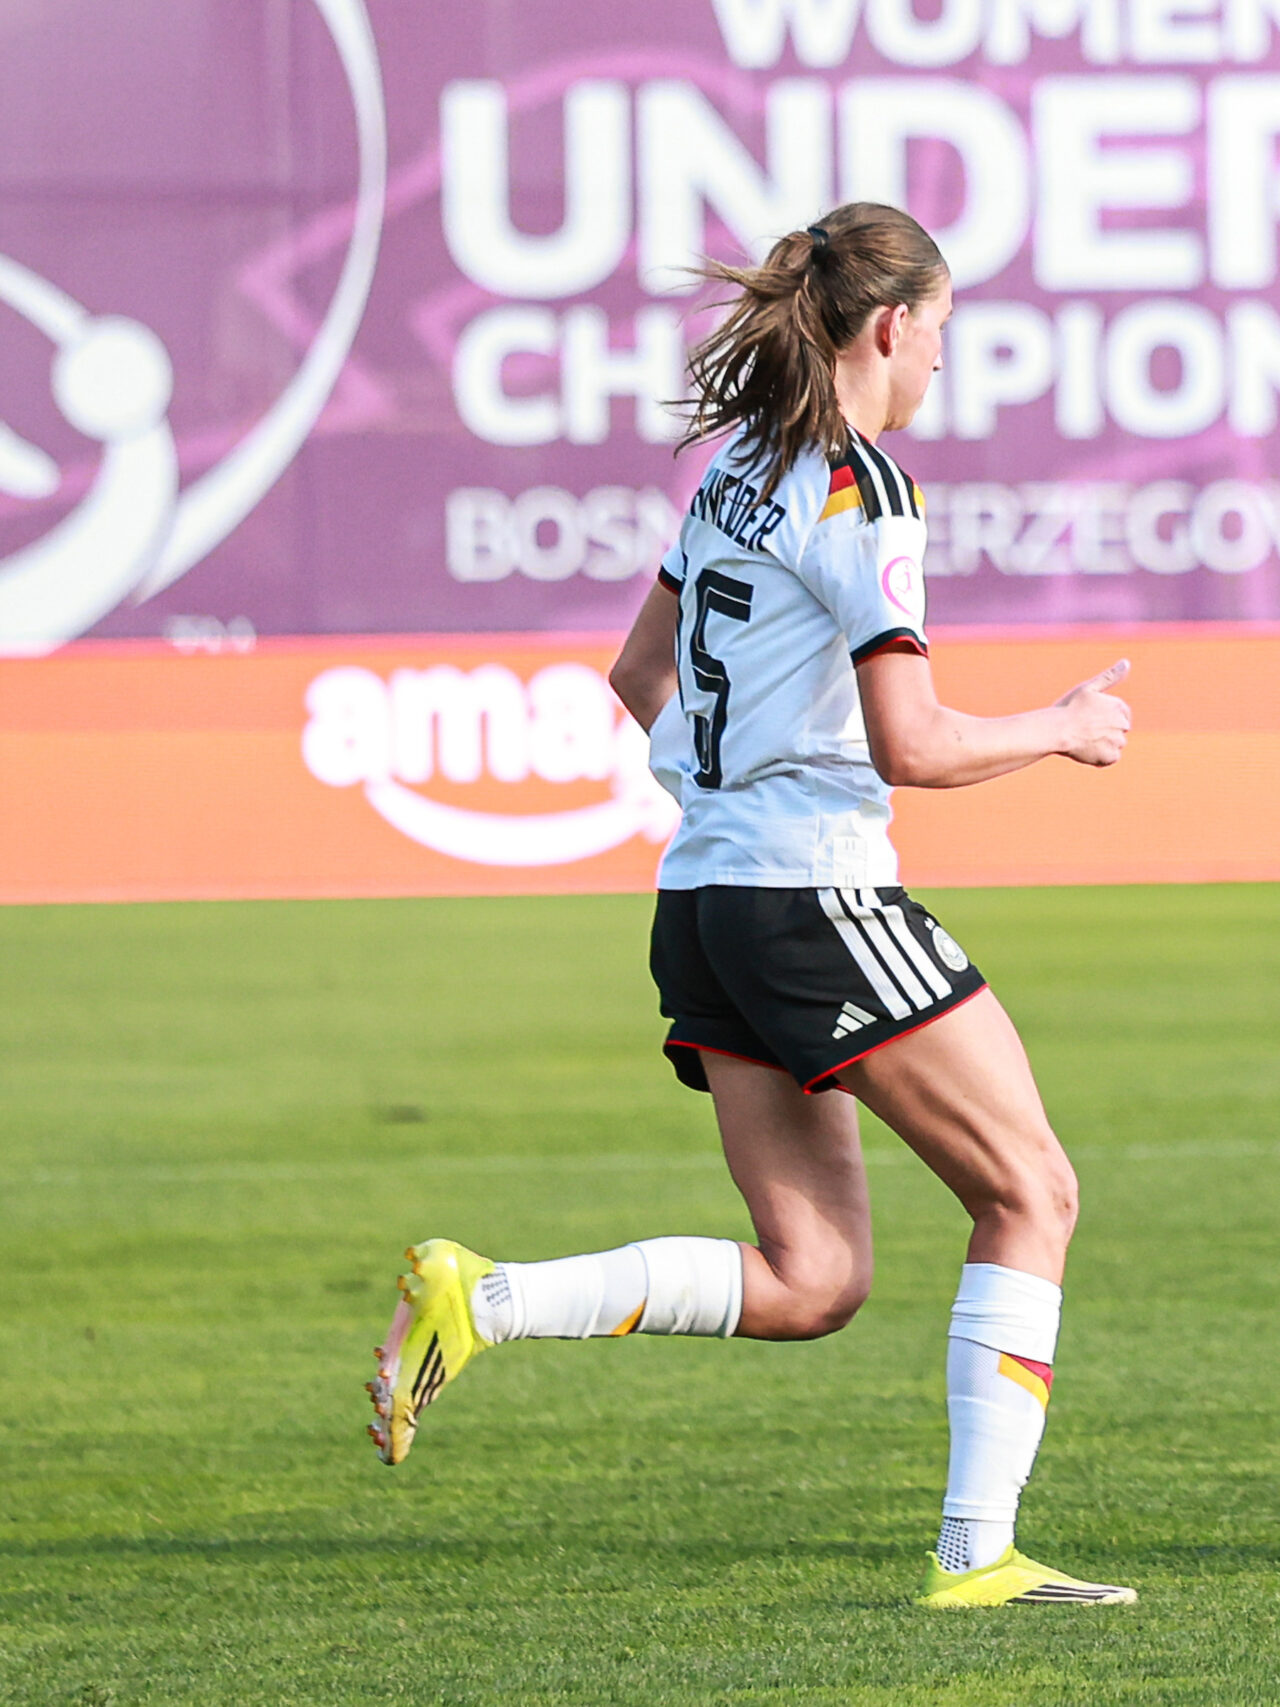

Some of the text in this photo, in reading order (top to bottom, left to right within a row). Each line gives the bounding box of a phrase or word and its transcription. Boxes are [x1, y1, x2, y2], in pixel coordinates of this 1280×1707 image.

[445, 484, 690, 582] BOSN
[301, 662, 650, 788] ama
[678, 553, 755, 790] 5
